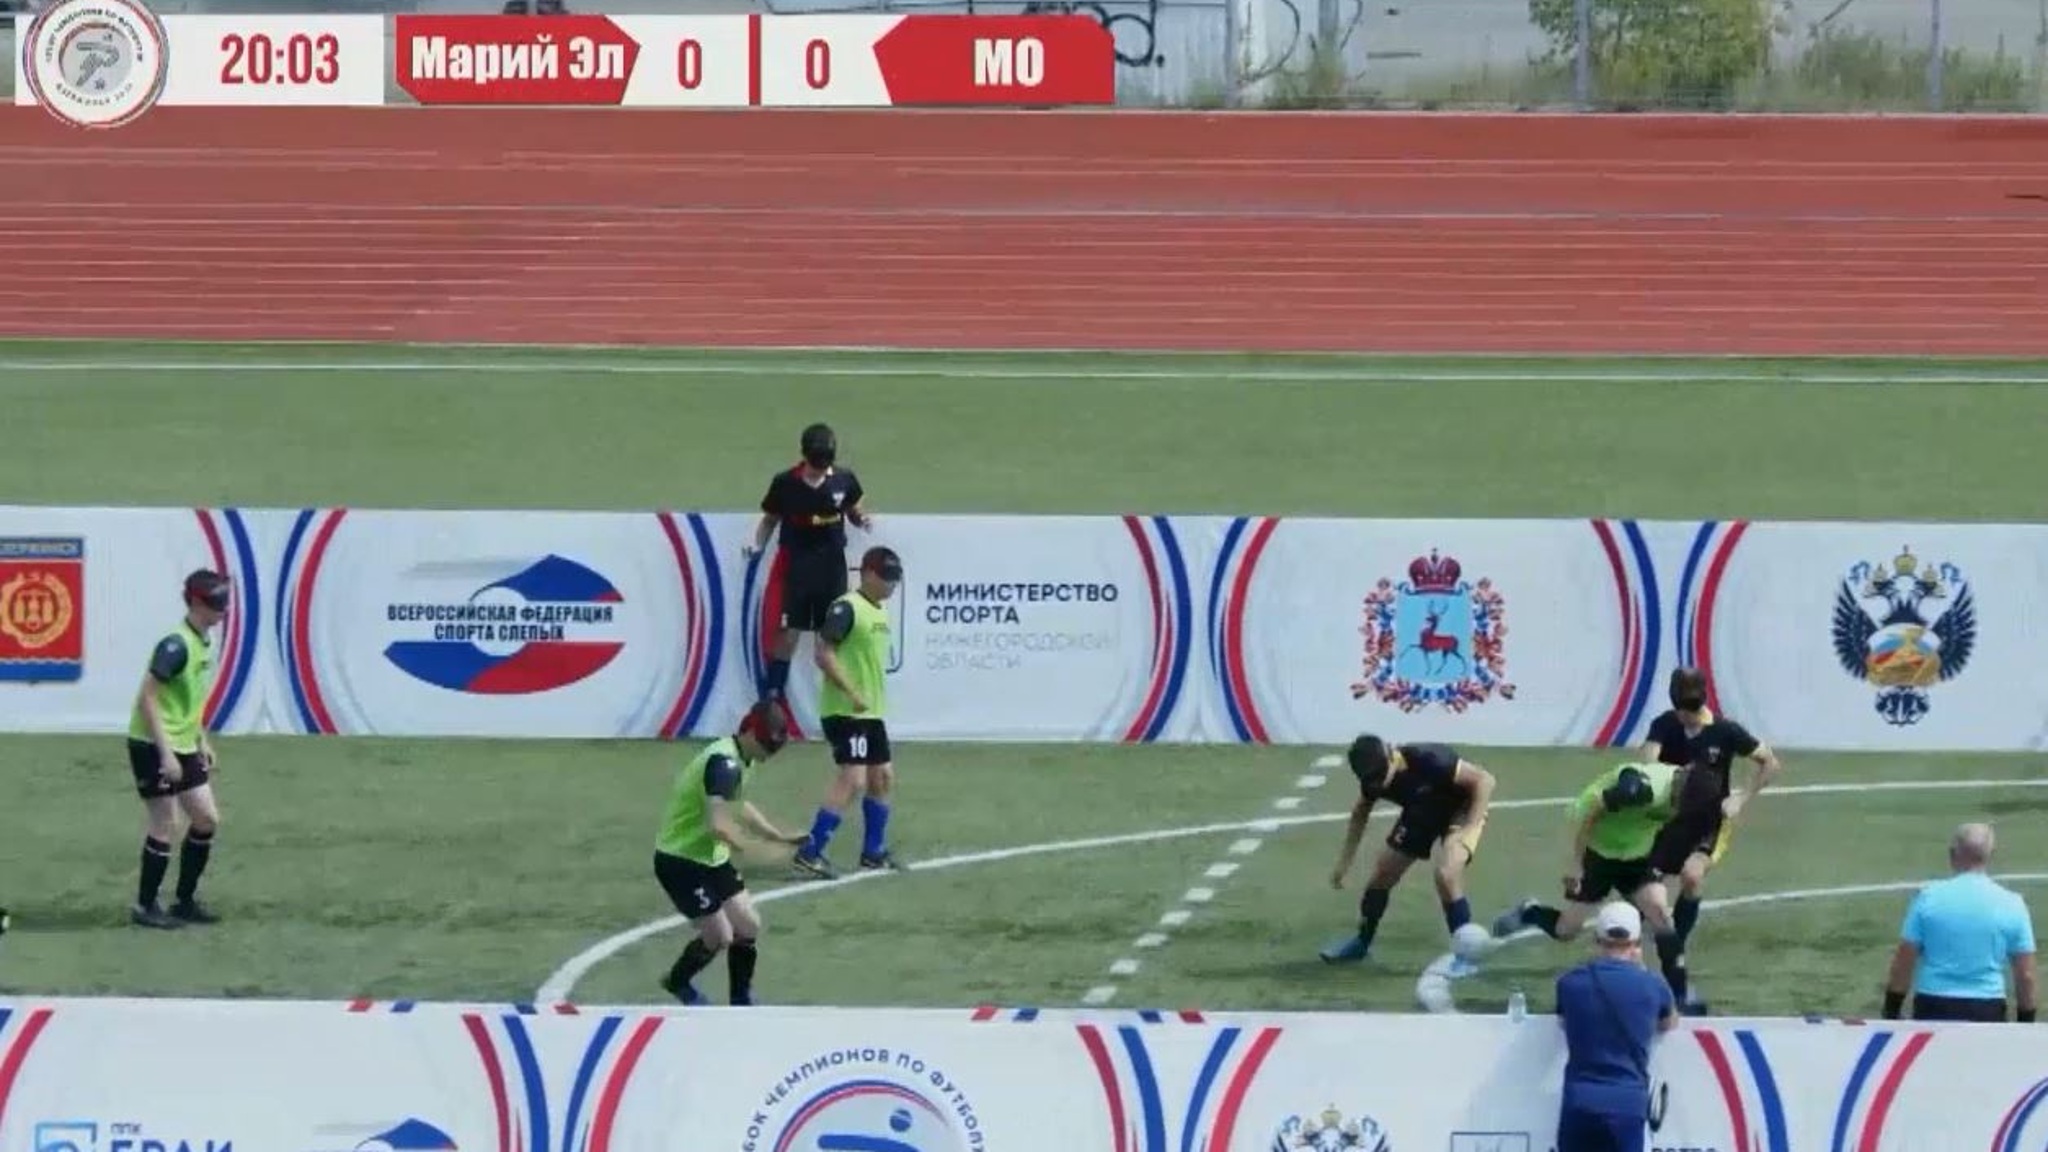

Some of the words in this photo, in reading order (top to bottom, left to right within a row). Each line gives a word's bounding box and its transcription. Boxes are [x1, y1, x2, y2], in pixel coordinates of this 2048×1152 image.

[926, 583, 1119, 601] МИНИСТЕРСТВО
[388, 604, 516, 621] ВСЕРОССИЙСКАЯ
[521, 604, 613, 624] ФЕДЕРАЦИЯ
[926, 605, 1020, 624] СПОРТА
[435, 624, 494, 641] СПОРТА
[499, 624, 565, 641] СЛЕПЫХ
[849, 736, 868, 758] 10
[765, 1049, 889, 1107] ЧЕМПИОНОВ
[896, 1053, 925, 1074] ПО
